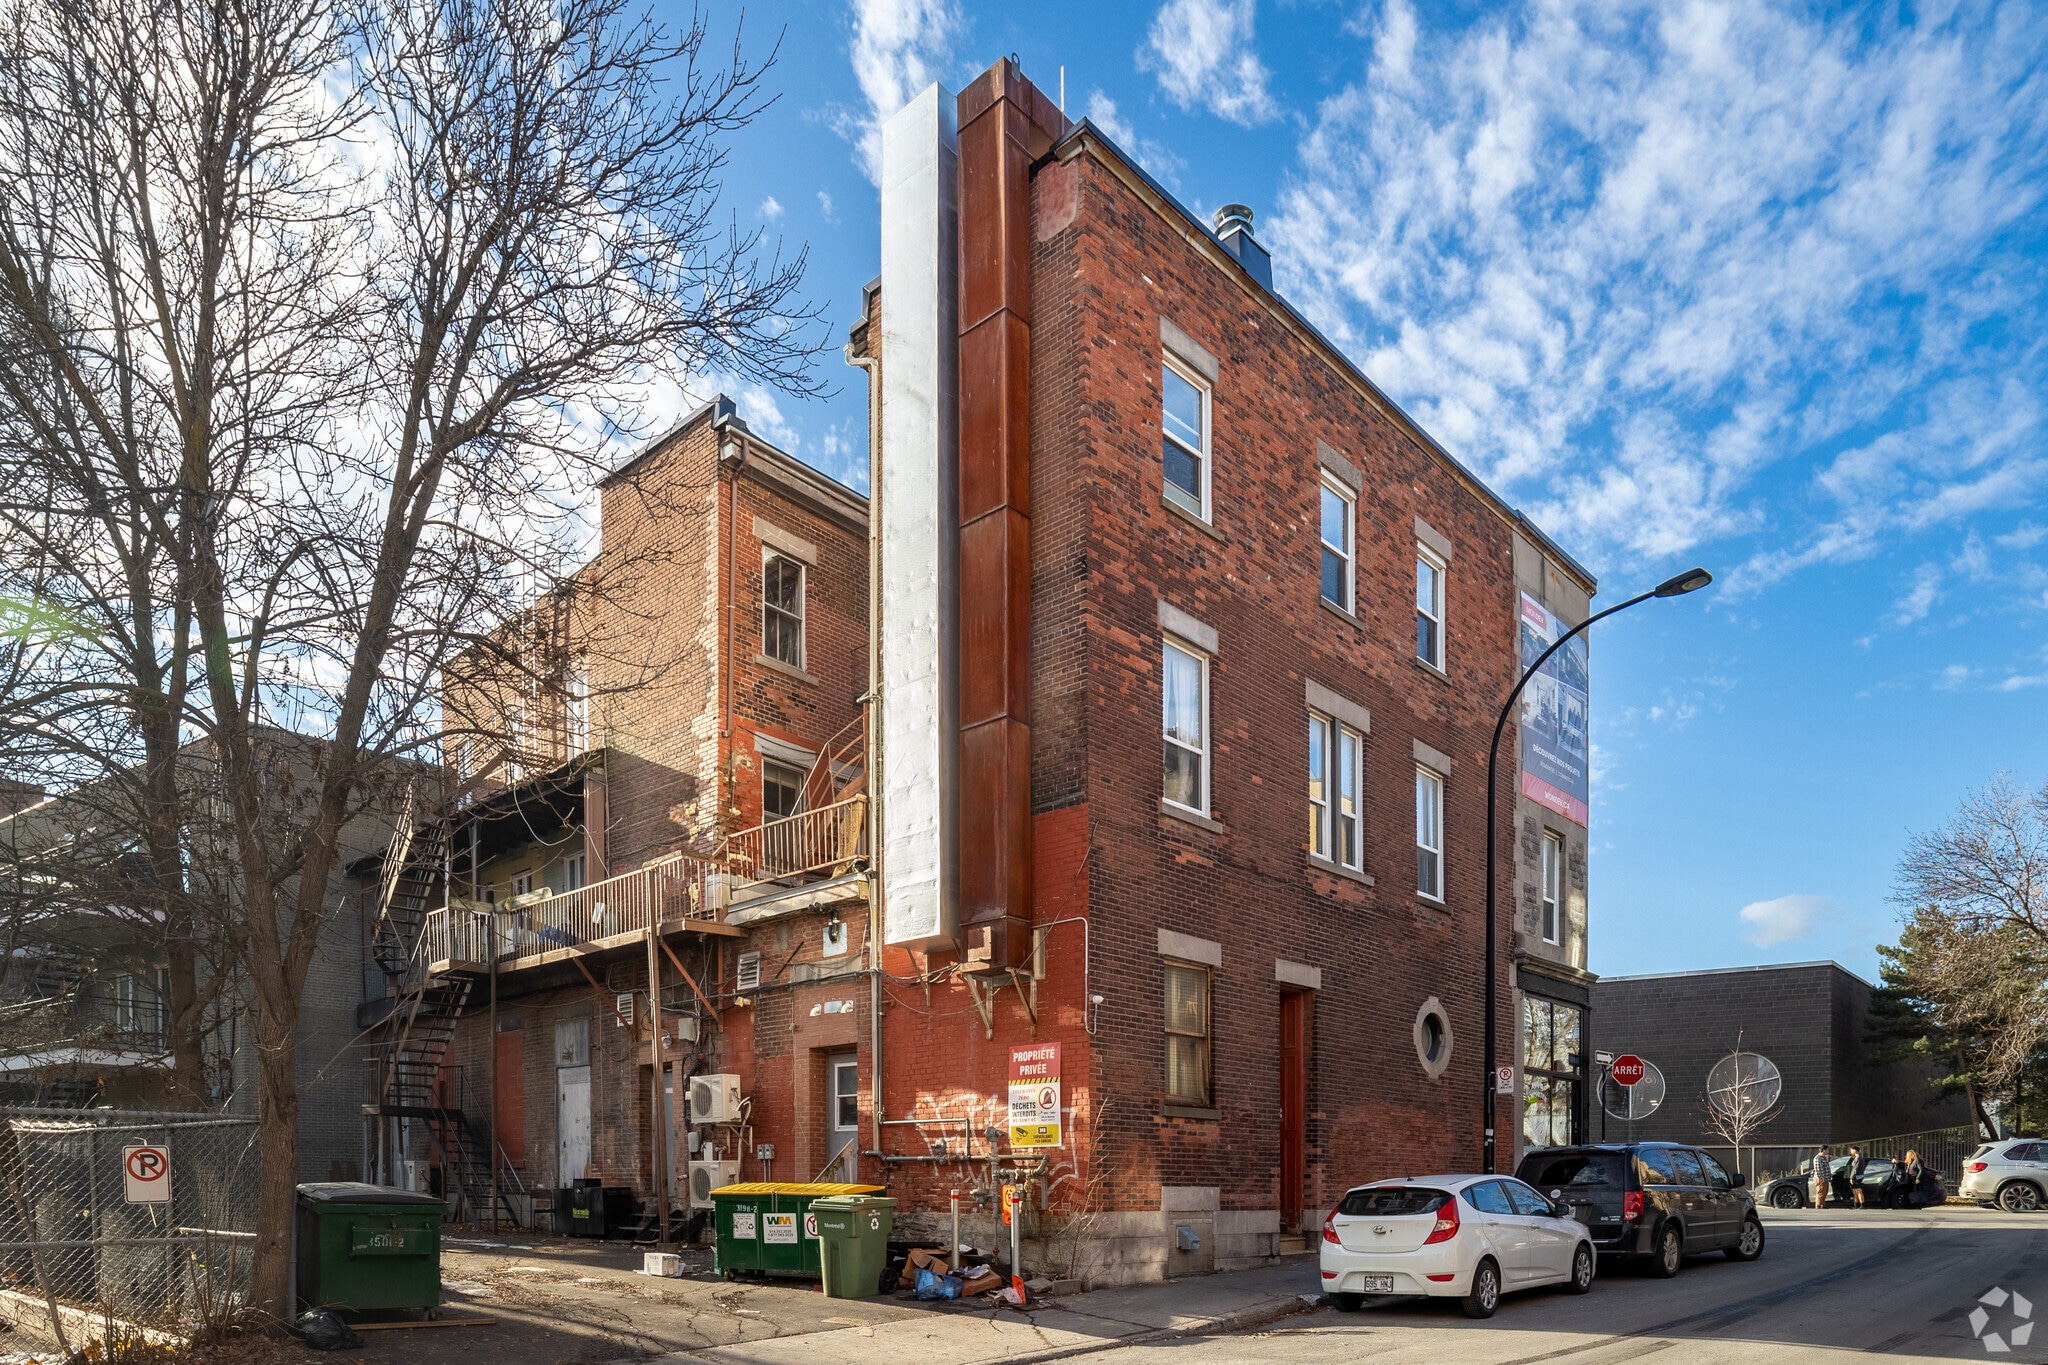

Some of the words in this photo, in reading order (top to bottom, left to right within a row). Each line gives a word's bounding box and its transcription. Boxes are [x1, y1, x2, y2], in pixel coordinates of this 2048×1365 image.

[1013, 1046, 1055, 1063] PROPRIÉTÉ
[1020, 1061, 1047, 1075] PRIVÉE
[1614, 1064, 1643, 1075] ARRÊT
[1012, 1101, 1036, 1110] DÉCHETS
[1012, 1110, 1036, 1118] INTERDITS
[766, 1216, 792, 1225] WM
